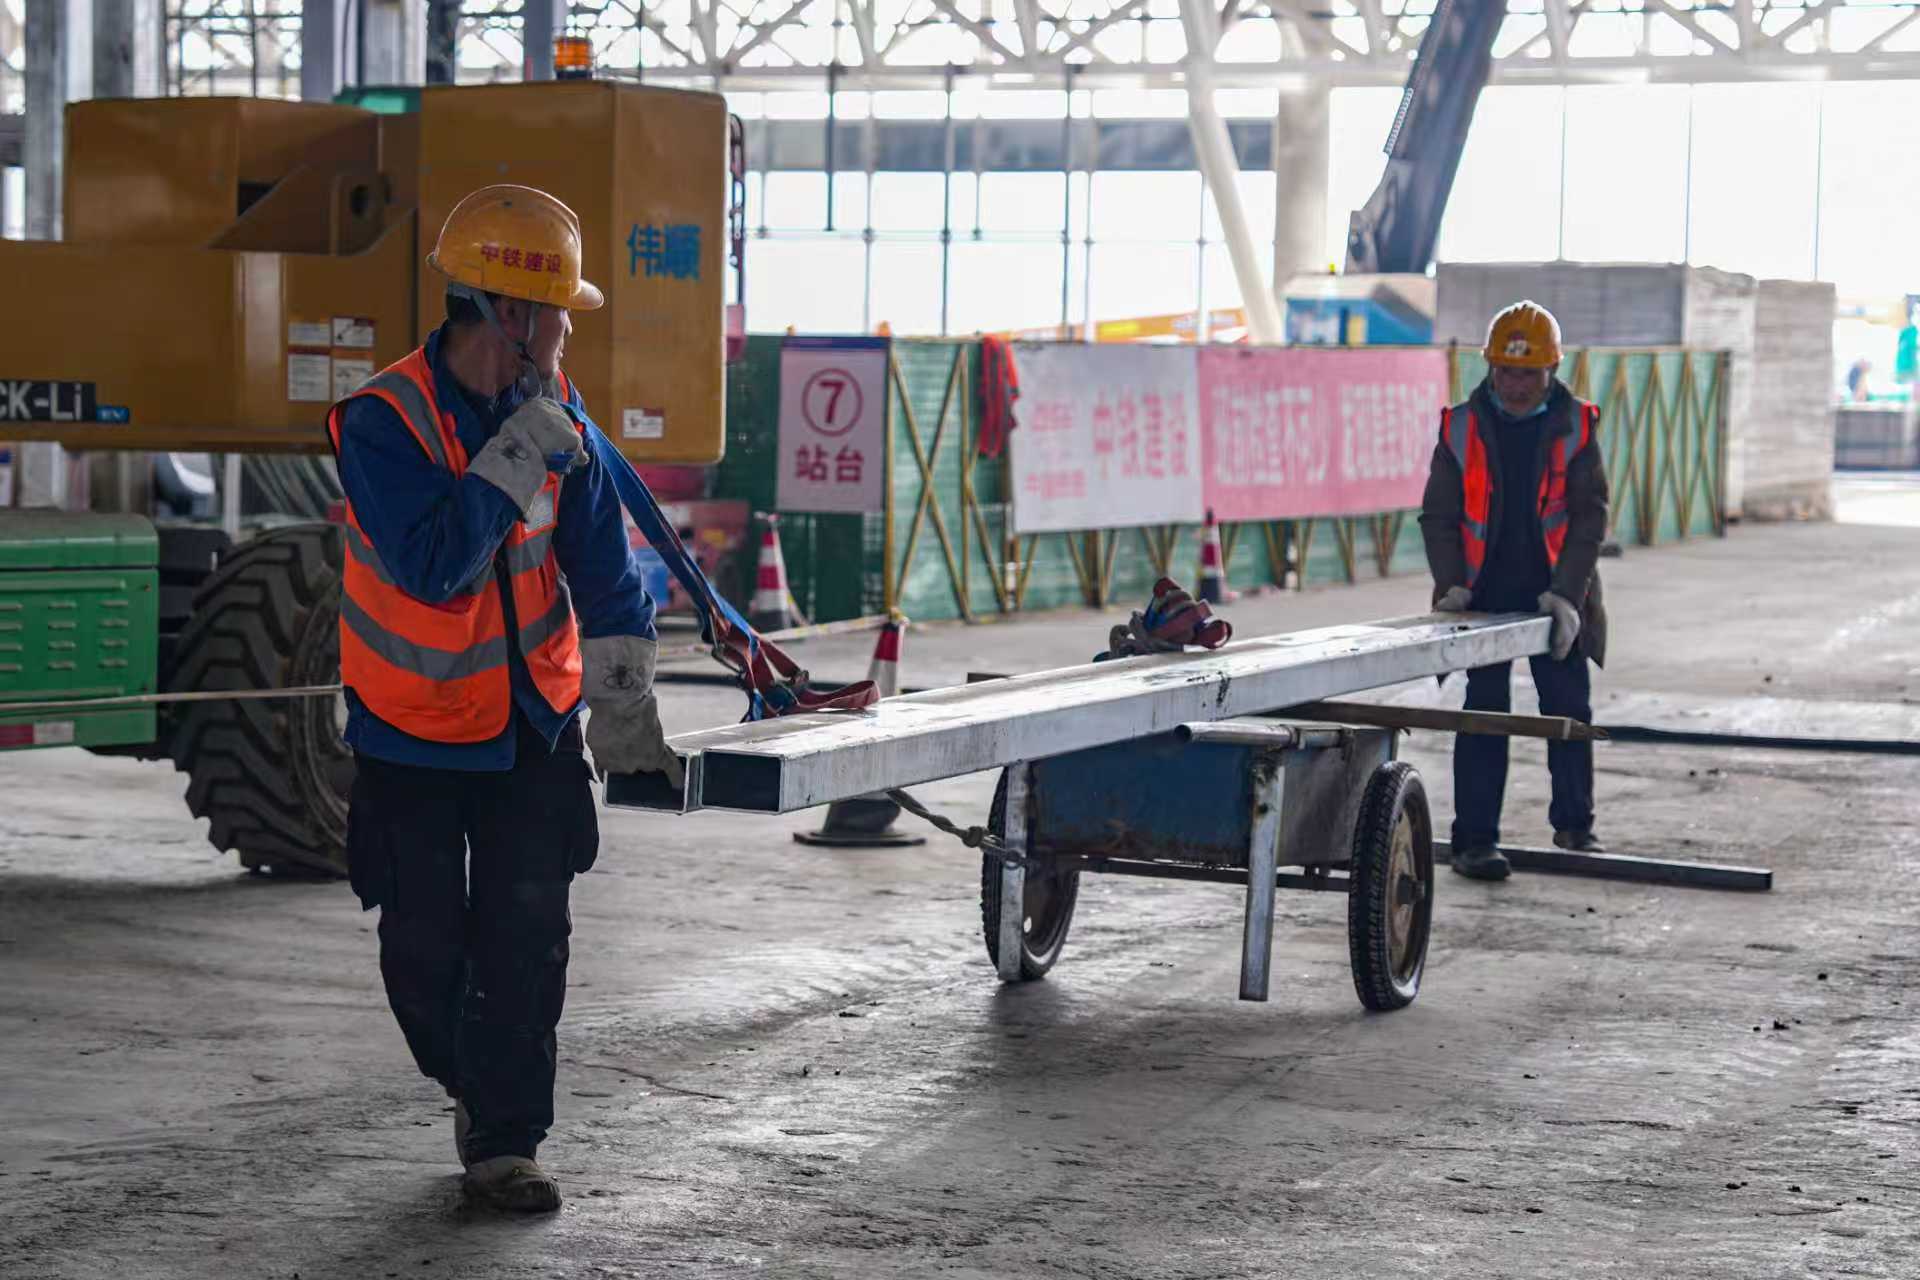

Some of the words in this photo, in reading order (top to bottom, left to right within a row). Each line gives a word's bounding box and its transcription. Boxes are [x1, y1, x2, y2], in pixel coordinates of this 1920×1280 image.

[481, 245, 562, 273] 中铁建设
[795, 444, 864, 483] 站台
